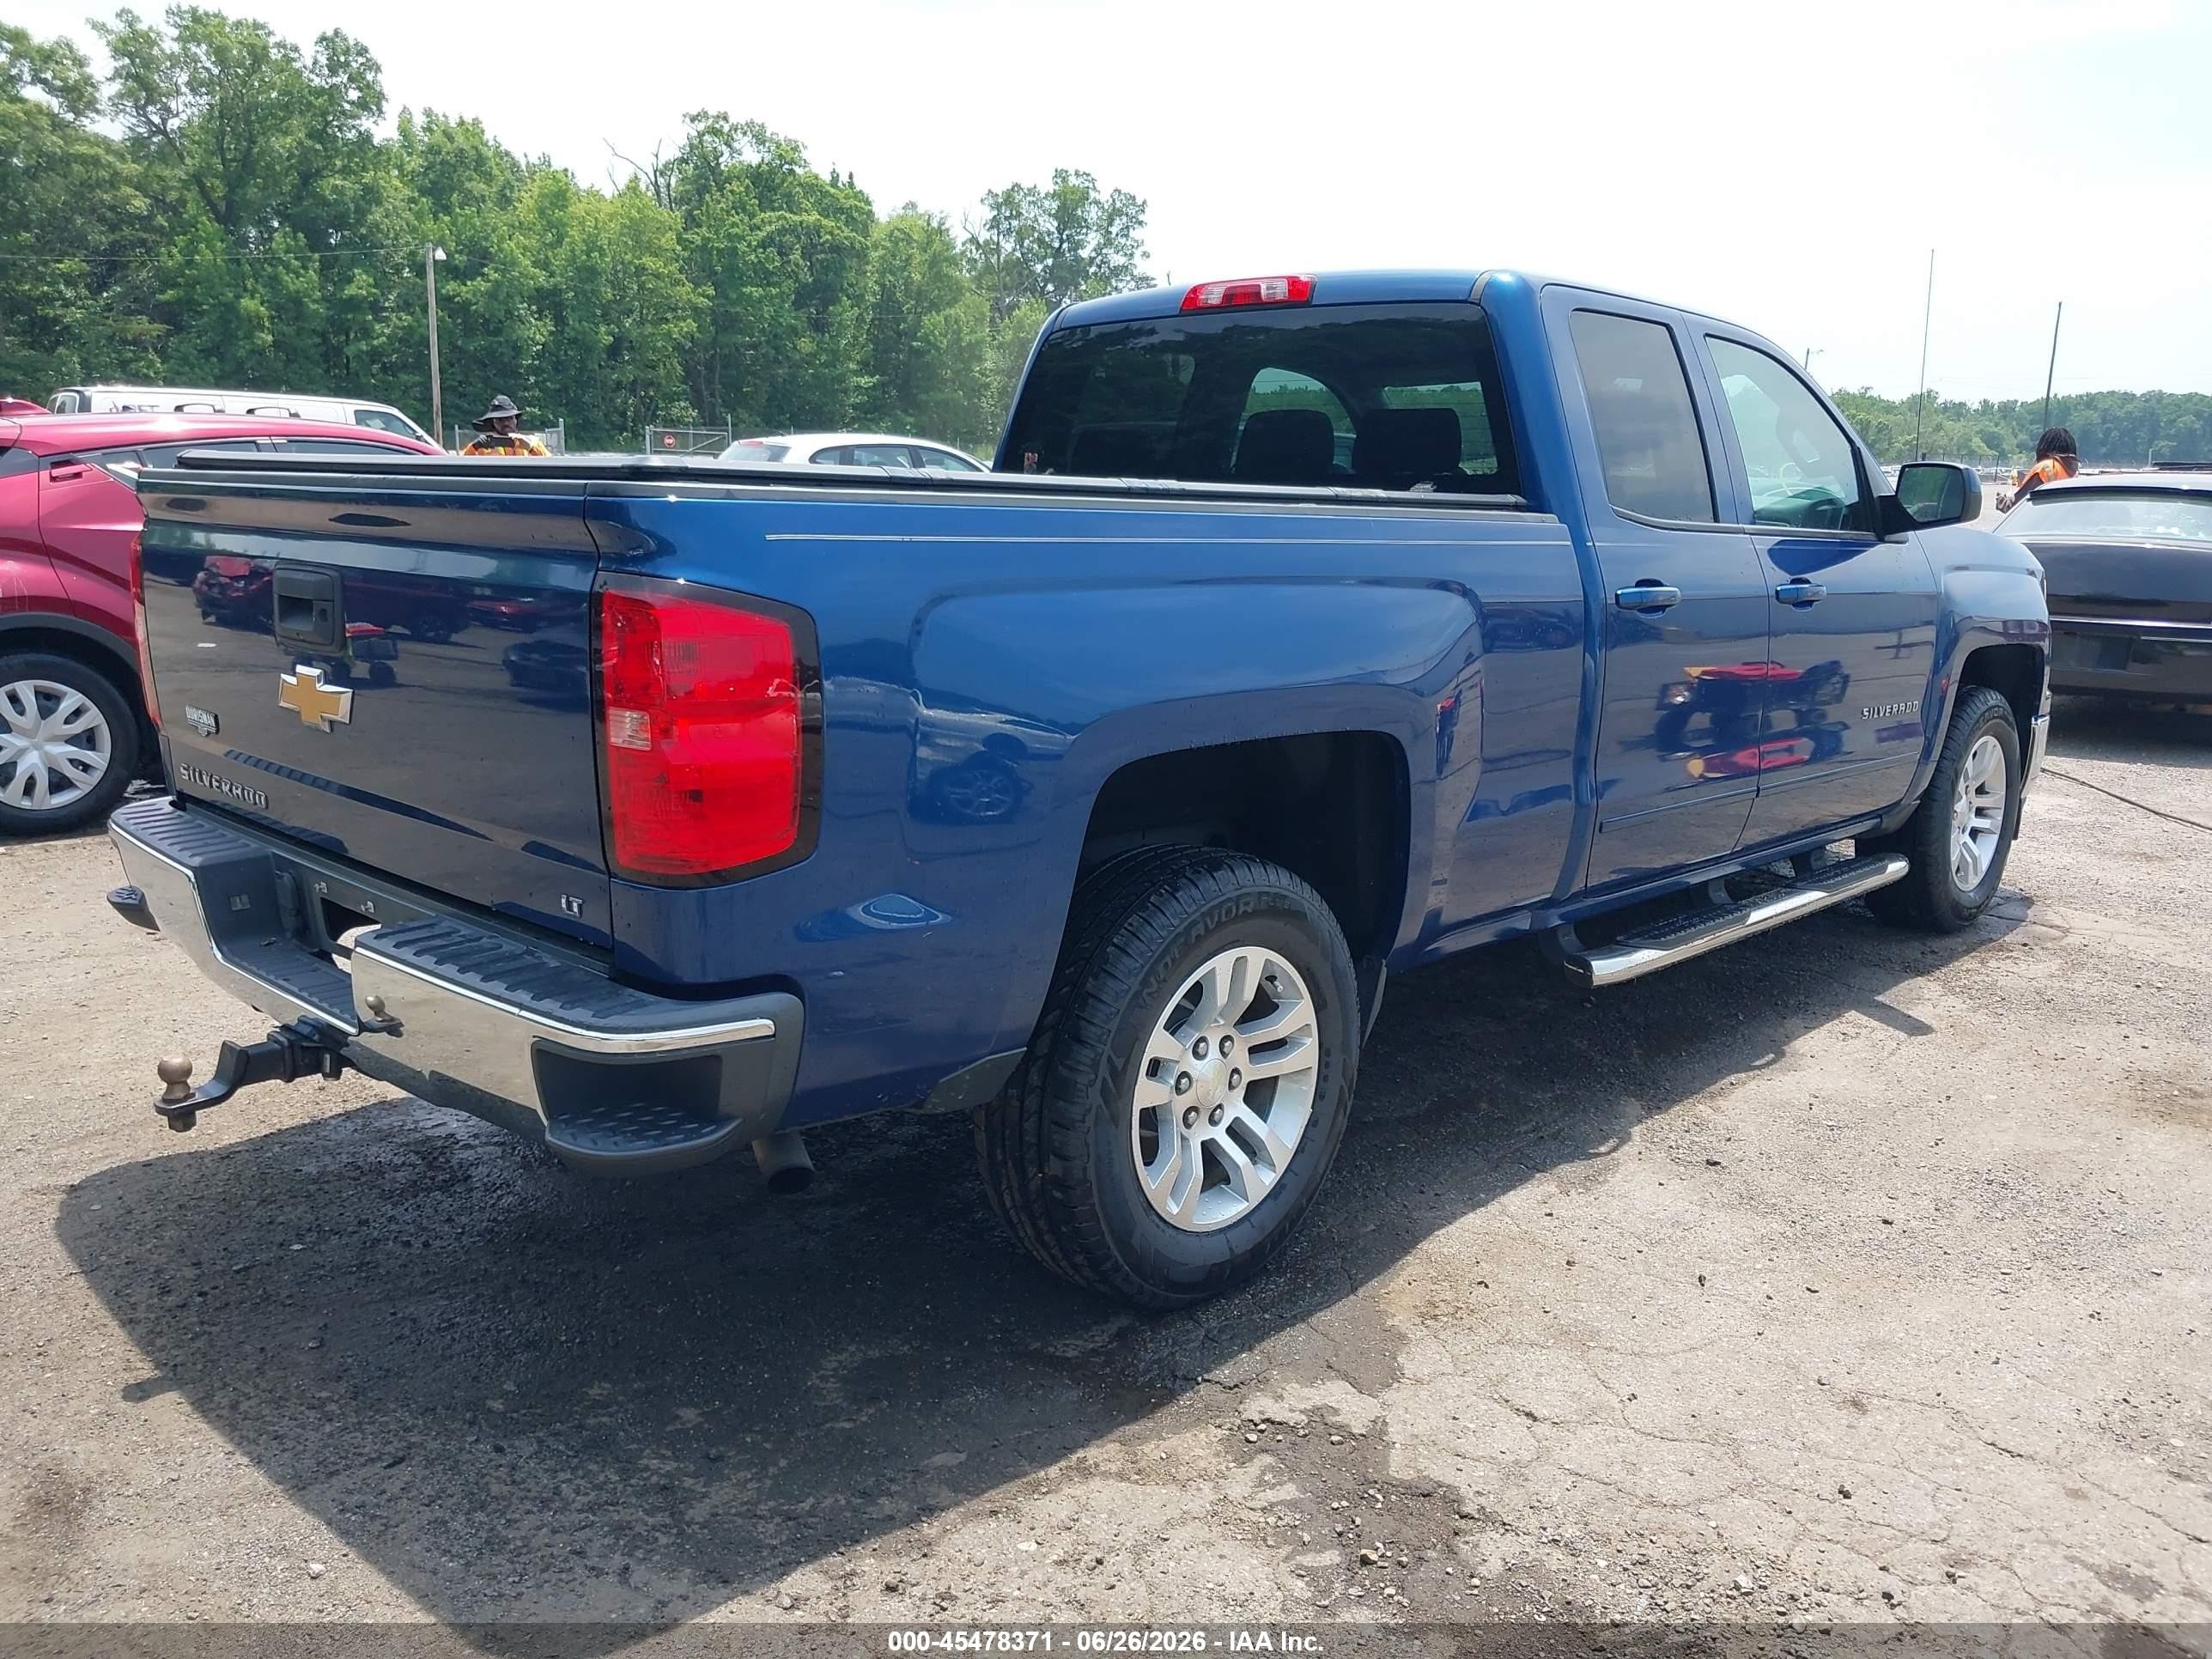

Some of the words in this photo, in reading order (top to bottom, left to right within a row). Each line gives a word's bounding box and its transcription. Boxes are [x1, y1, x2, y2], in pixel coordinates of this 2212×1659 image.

[1862, 701, 1919, 720] SILVERADO
[179, 763, 268, 809] SILVERADO
[561, 894, 582, 918] LT
